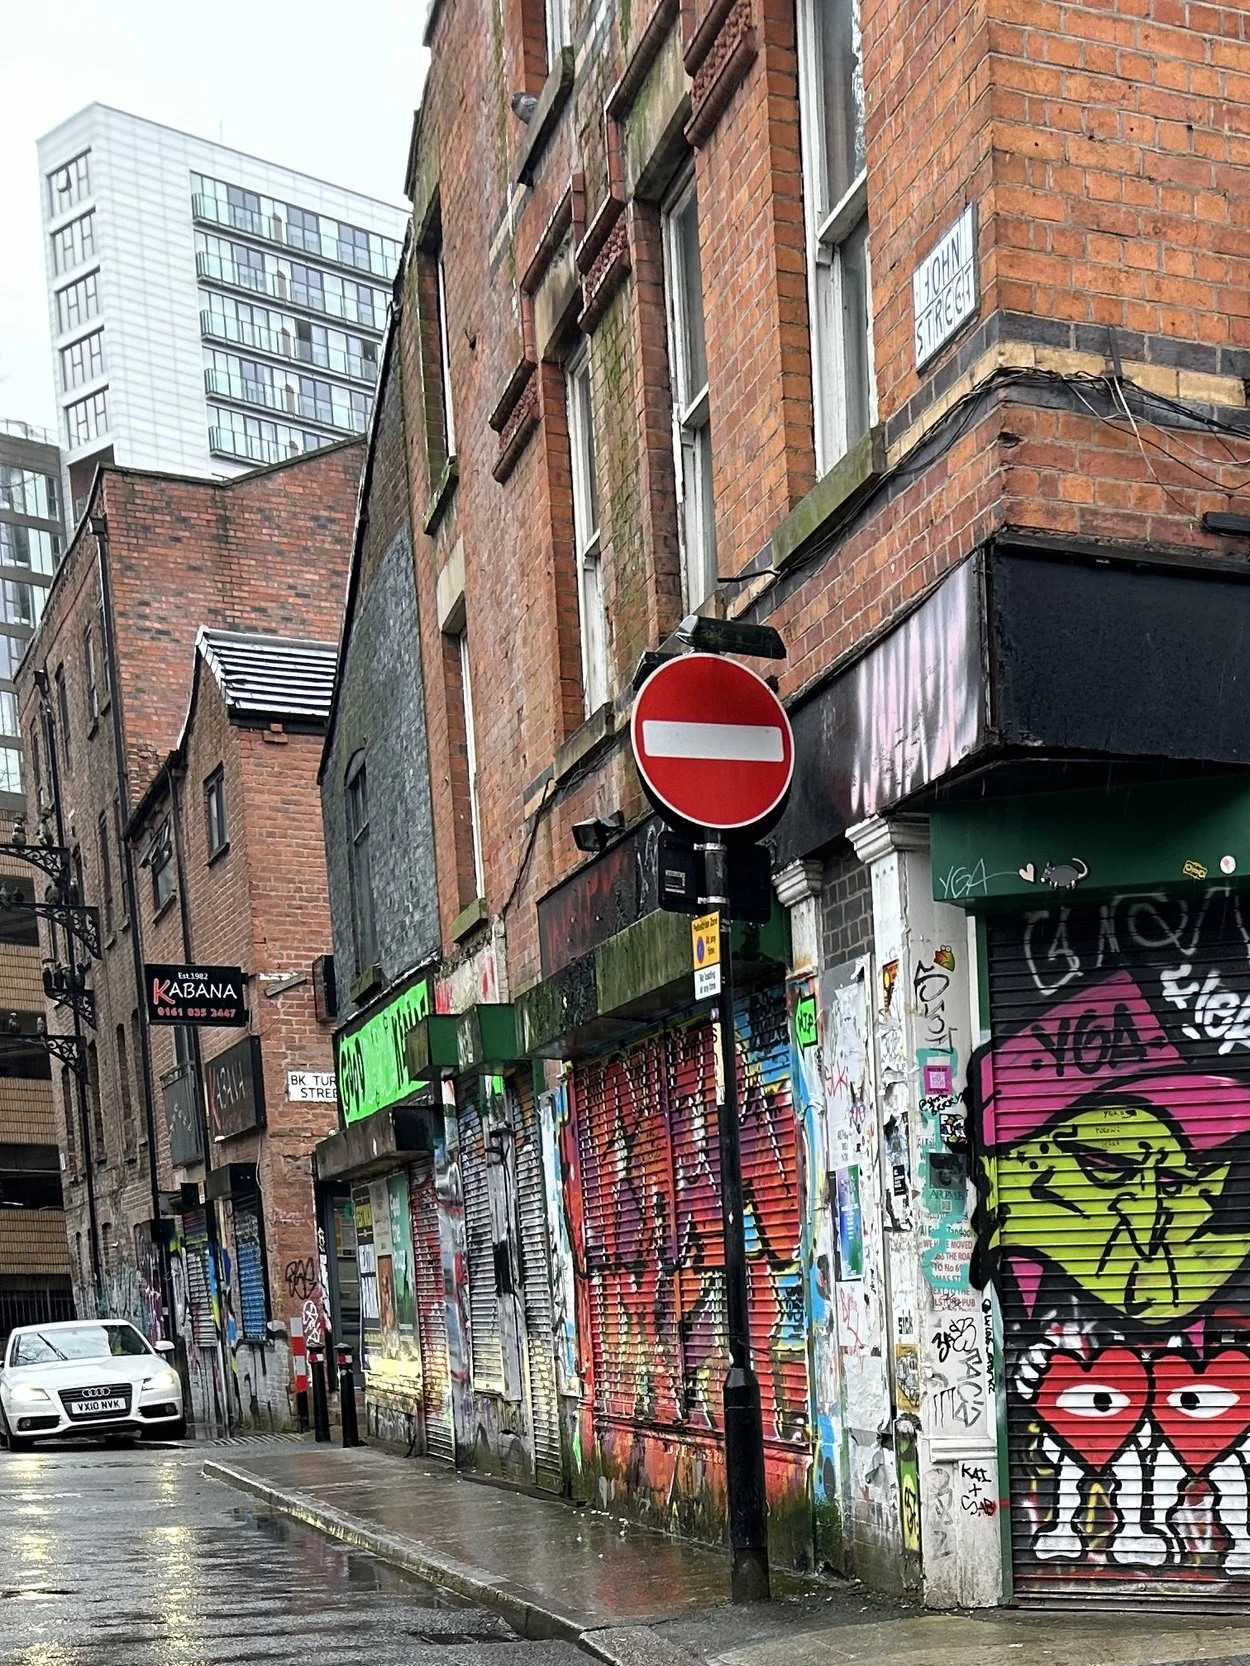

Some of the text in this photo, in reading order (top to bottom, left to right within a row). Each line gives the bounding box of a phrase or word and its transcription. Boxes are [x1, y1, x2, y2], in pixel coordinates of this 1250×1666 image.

[925, 231, 960, 303] JOHN
[916, 264, 971, 357] STREET
[153, 978, 238, 1005] KABANA
[300, 1088, 337, 1098] STREE
[315, 1076, 336, 1086] TUR
